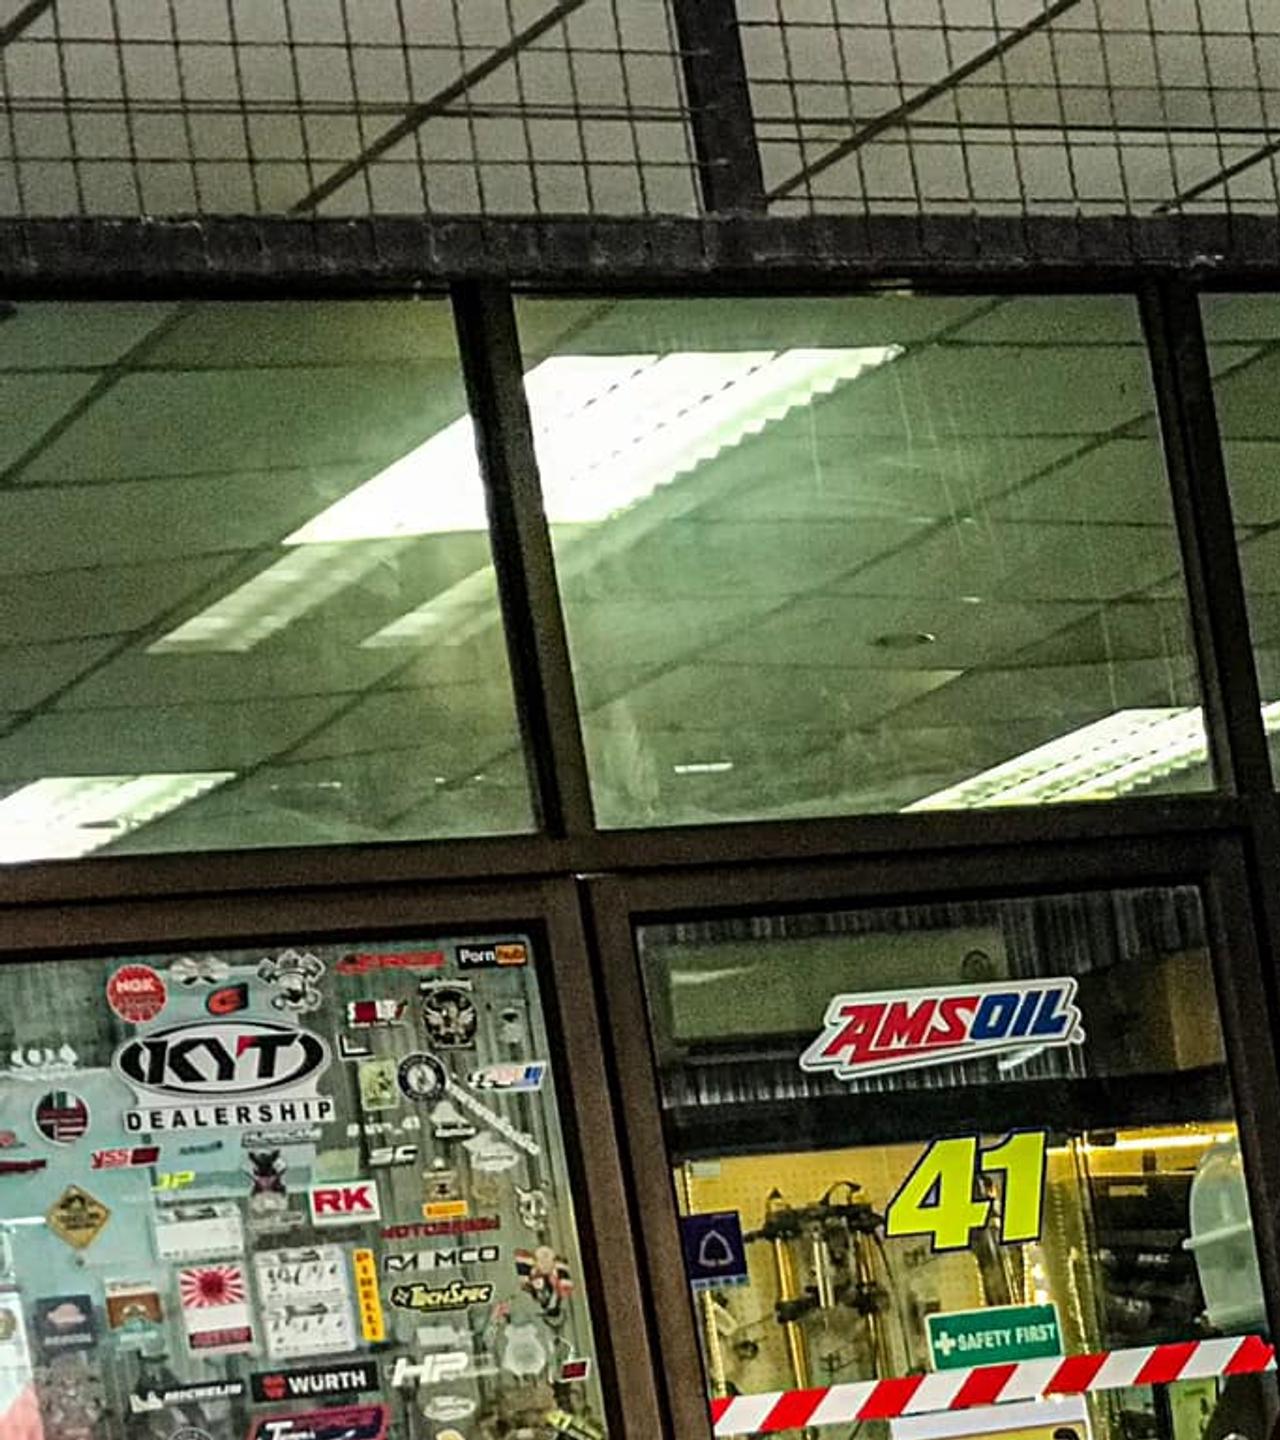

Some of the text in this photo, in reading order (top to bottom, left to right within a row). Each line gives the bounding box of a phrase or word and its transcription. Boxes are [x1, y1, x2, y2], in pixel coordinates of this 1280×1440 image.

[116, 978, 156, 993] NGK
[822, 989, 1069, 1066] AMSOIL
[138, 1031, 306, 1086] KYT
[127, 1101, 331, 1131] DEALERSHIP
[314, 1186, 372, 1213] RK
[887, 1128, 1051, 1252] 41
[957, 1322, 1056, 1351] SAFETY FIRST
